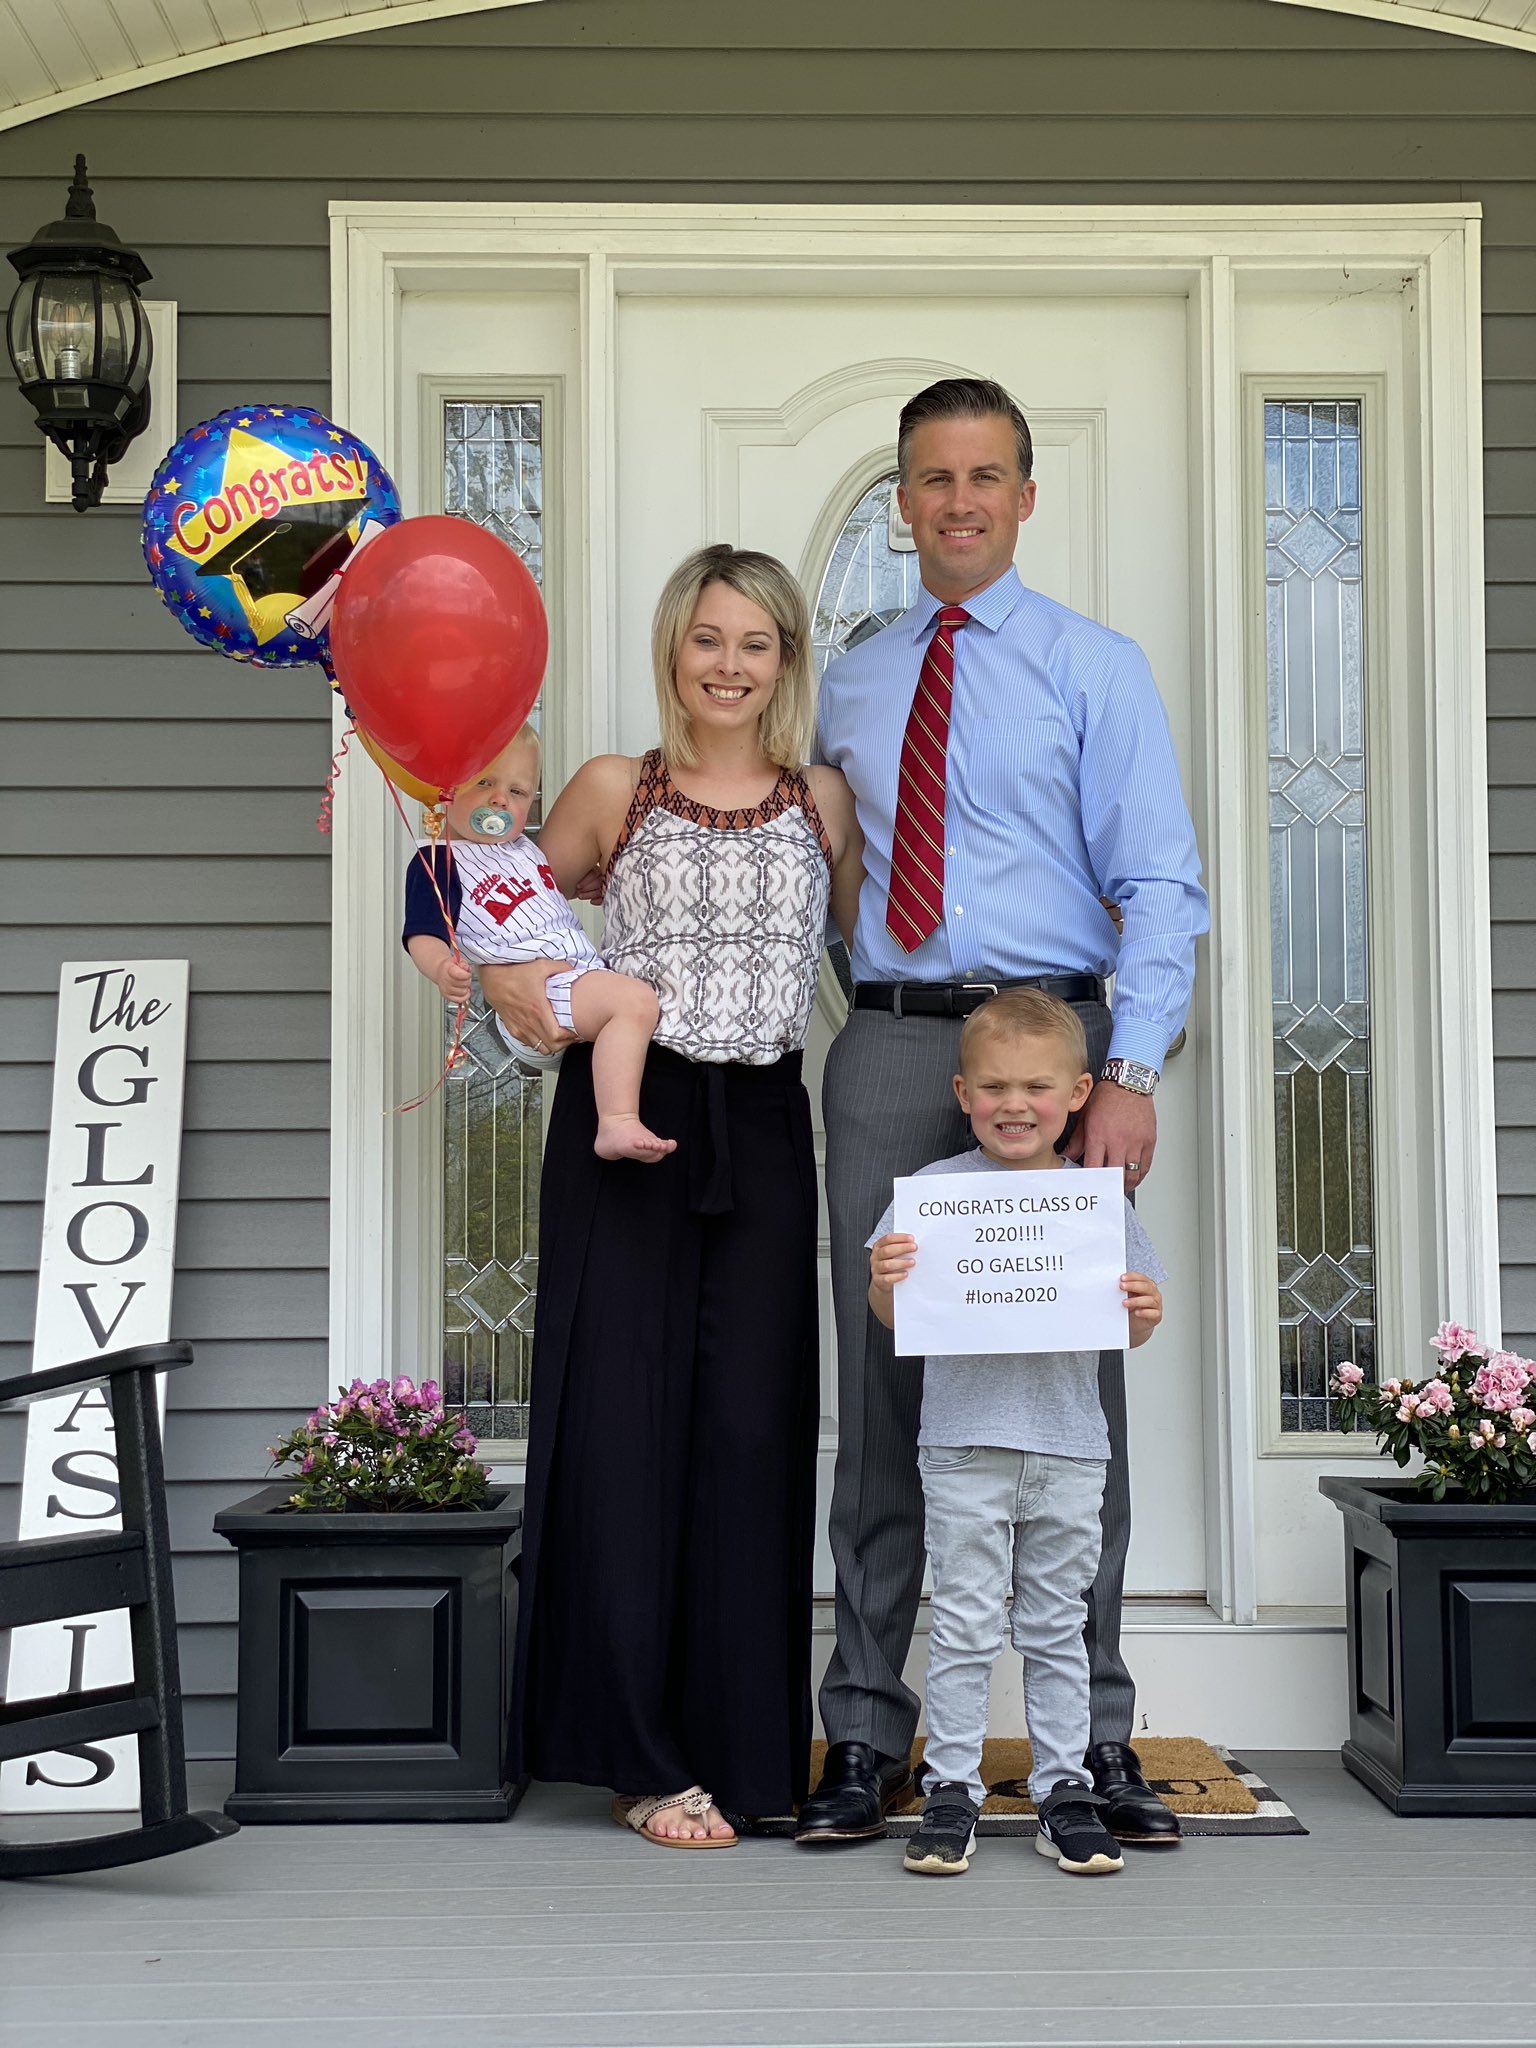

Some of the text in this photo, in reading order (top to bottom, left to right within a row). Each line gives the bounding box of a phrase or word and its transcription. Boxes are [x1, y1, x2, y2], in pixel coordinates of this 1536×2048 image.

[174, 448, 368, 555] Congrats!
[470, 873, 501, 906] Little
[74, 968, 172, 1033] The
[918, 1195, 1098, 1217] CONGRATS CLASS OF
[975, 1225, 1044, 1243] 2020!!!!
[957, 1255, 1064, 1274] GO GAELS!!!
[965, 1286, 1058, 1305] #Iona2020
[26, 1044, 159, 1787] GLOVASIS
